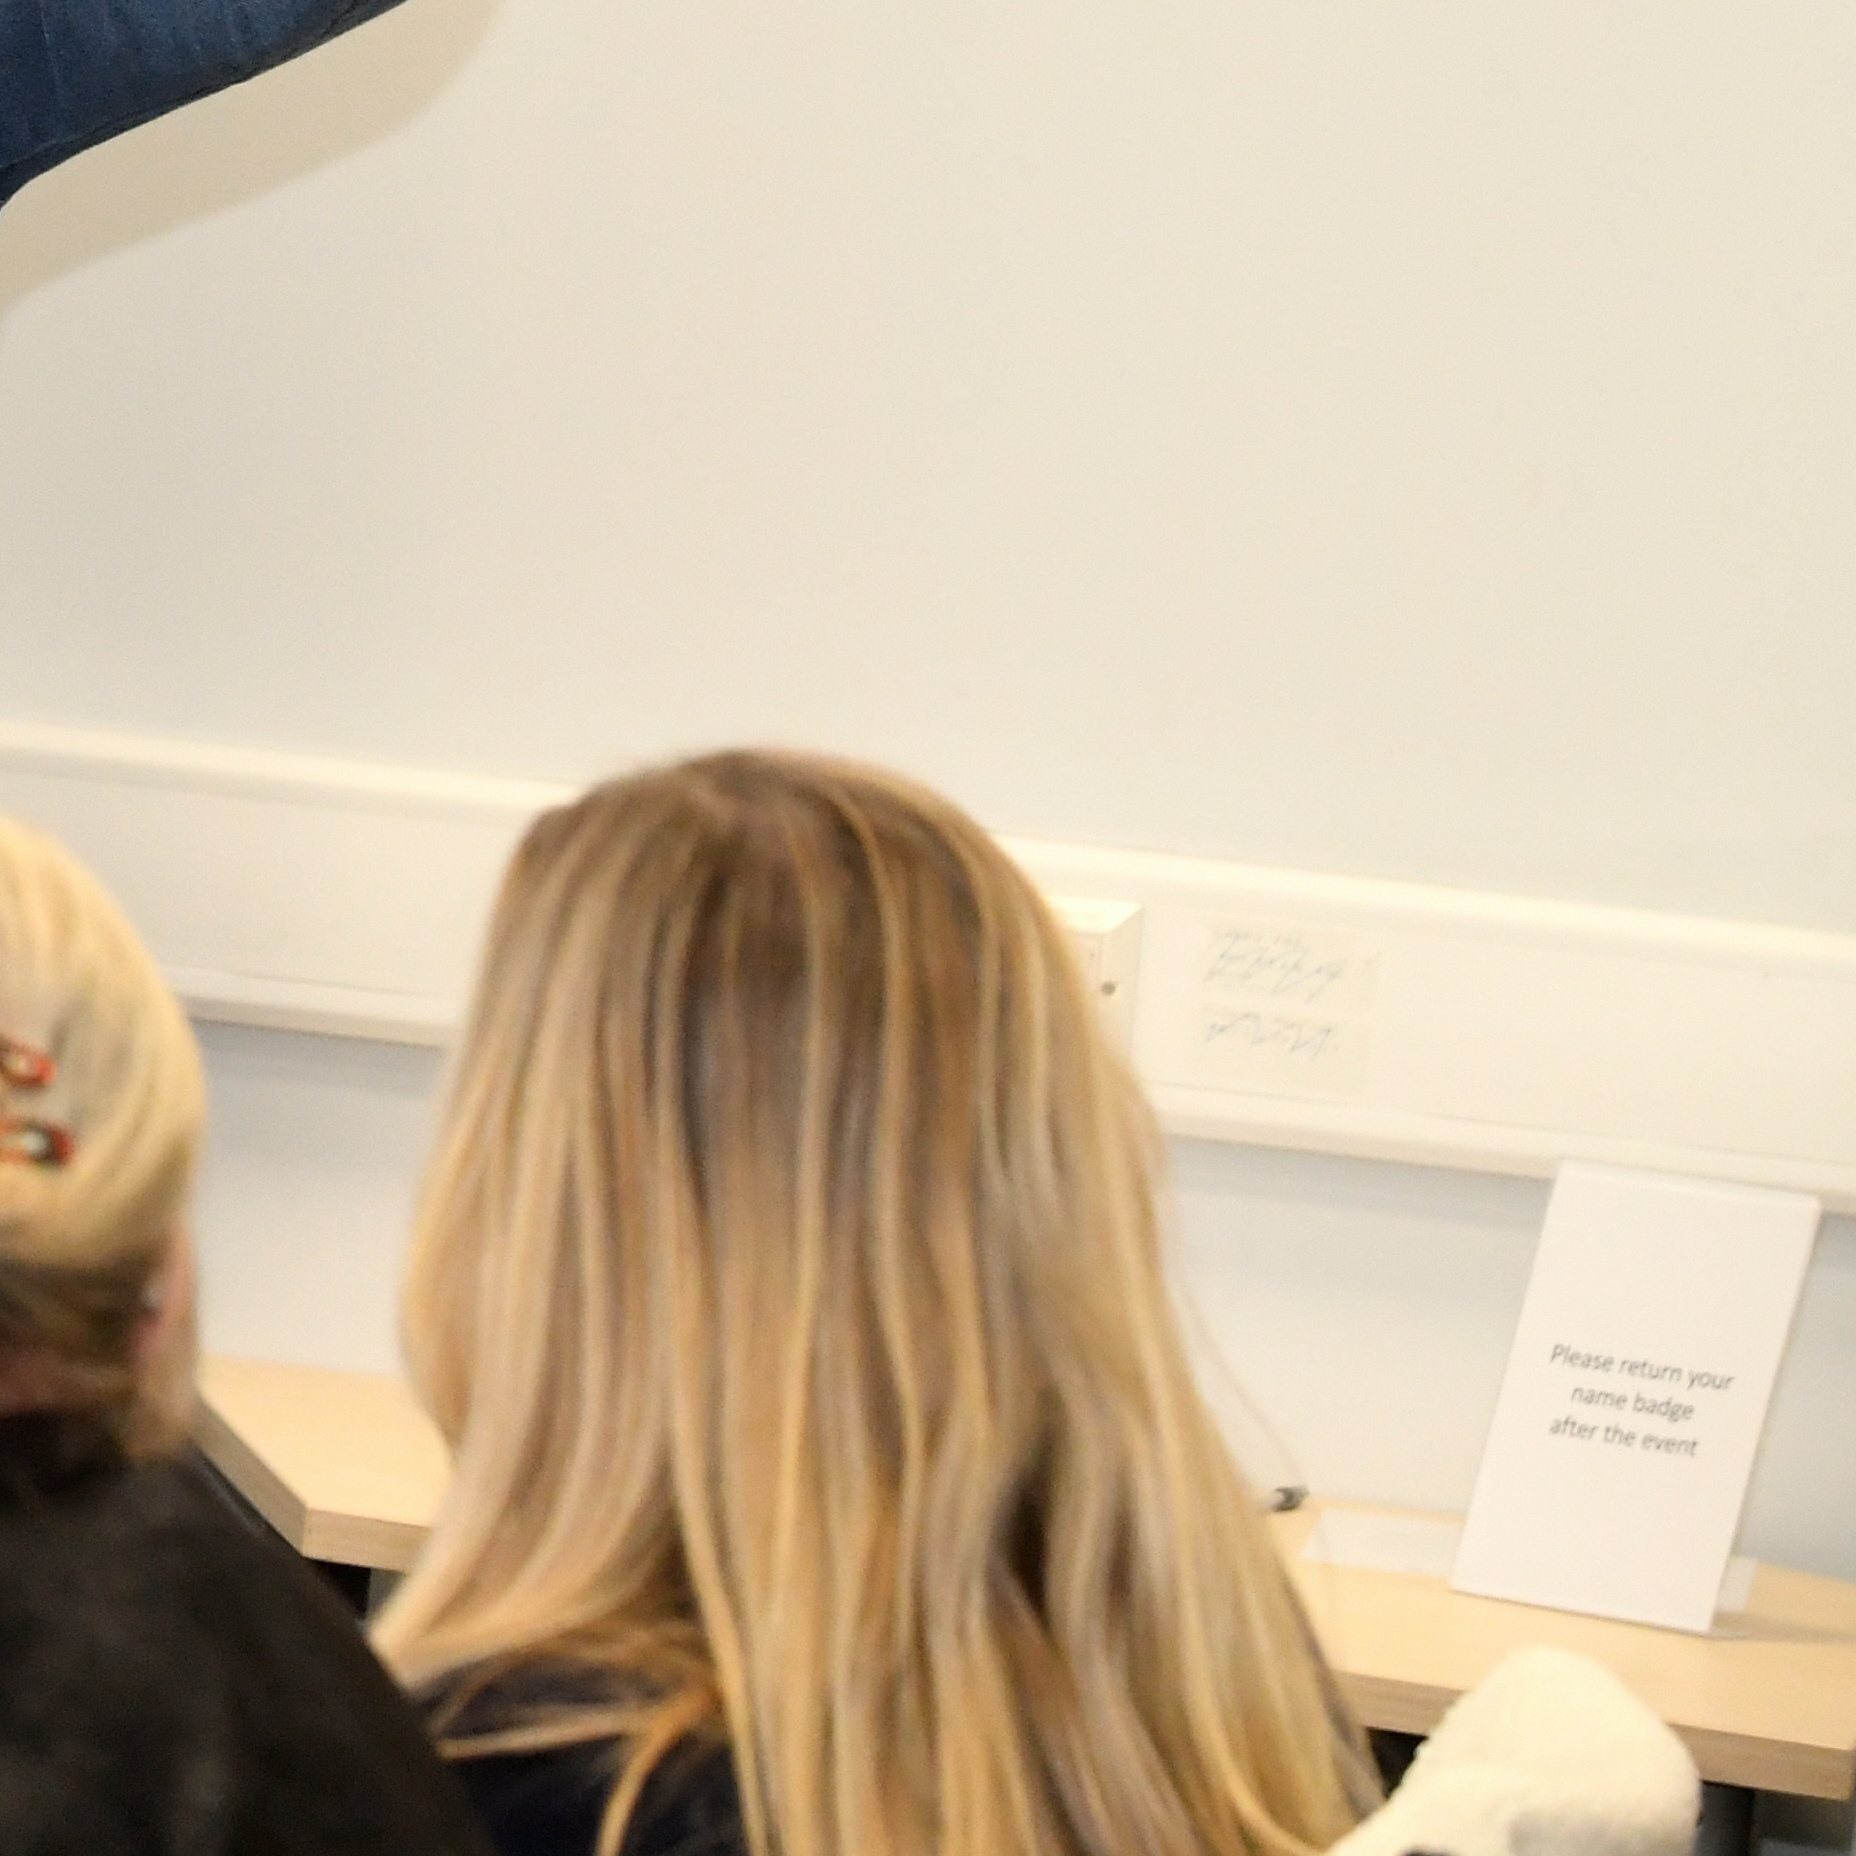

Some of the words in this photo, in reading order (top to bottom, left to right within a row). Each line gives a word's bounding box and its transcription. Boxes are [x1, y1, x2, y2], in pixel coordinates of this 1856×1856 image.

[1550, 1343, 1615, 1373] Please
[1618, 1356, 1683, 1383] return
[1687, 1369, 1735, 1391] your
[1571, 1385, 1628, 1410] name
[1633, 1391, 1695, 1423] badge
[1549, 1415, 1598, 1442] after
[1603, 1423, 1637, 1445] the
[1640, 1432, 1699, 1457] event
